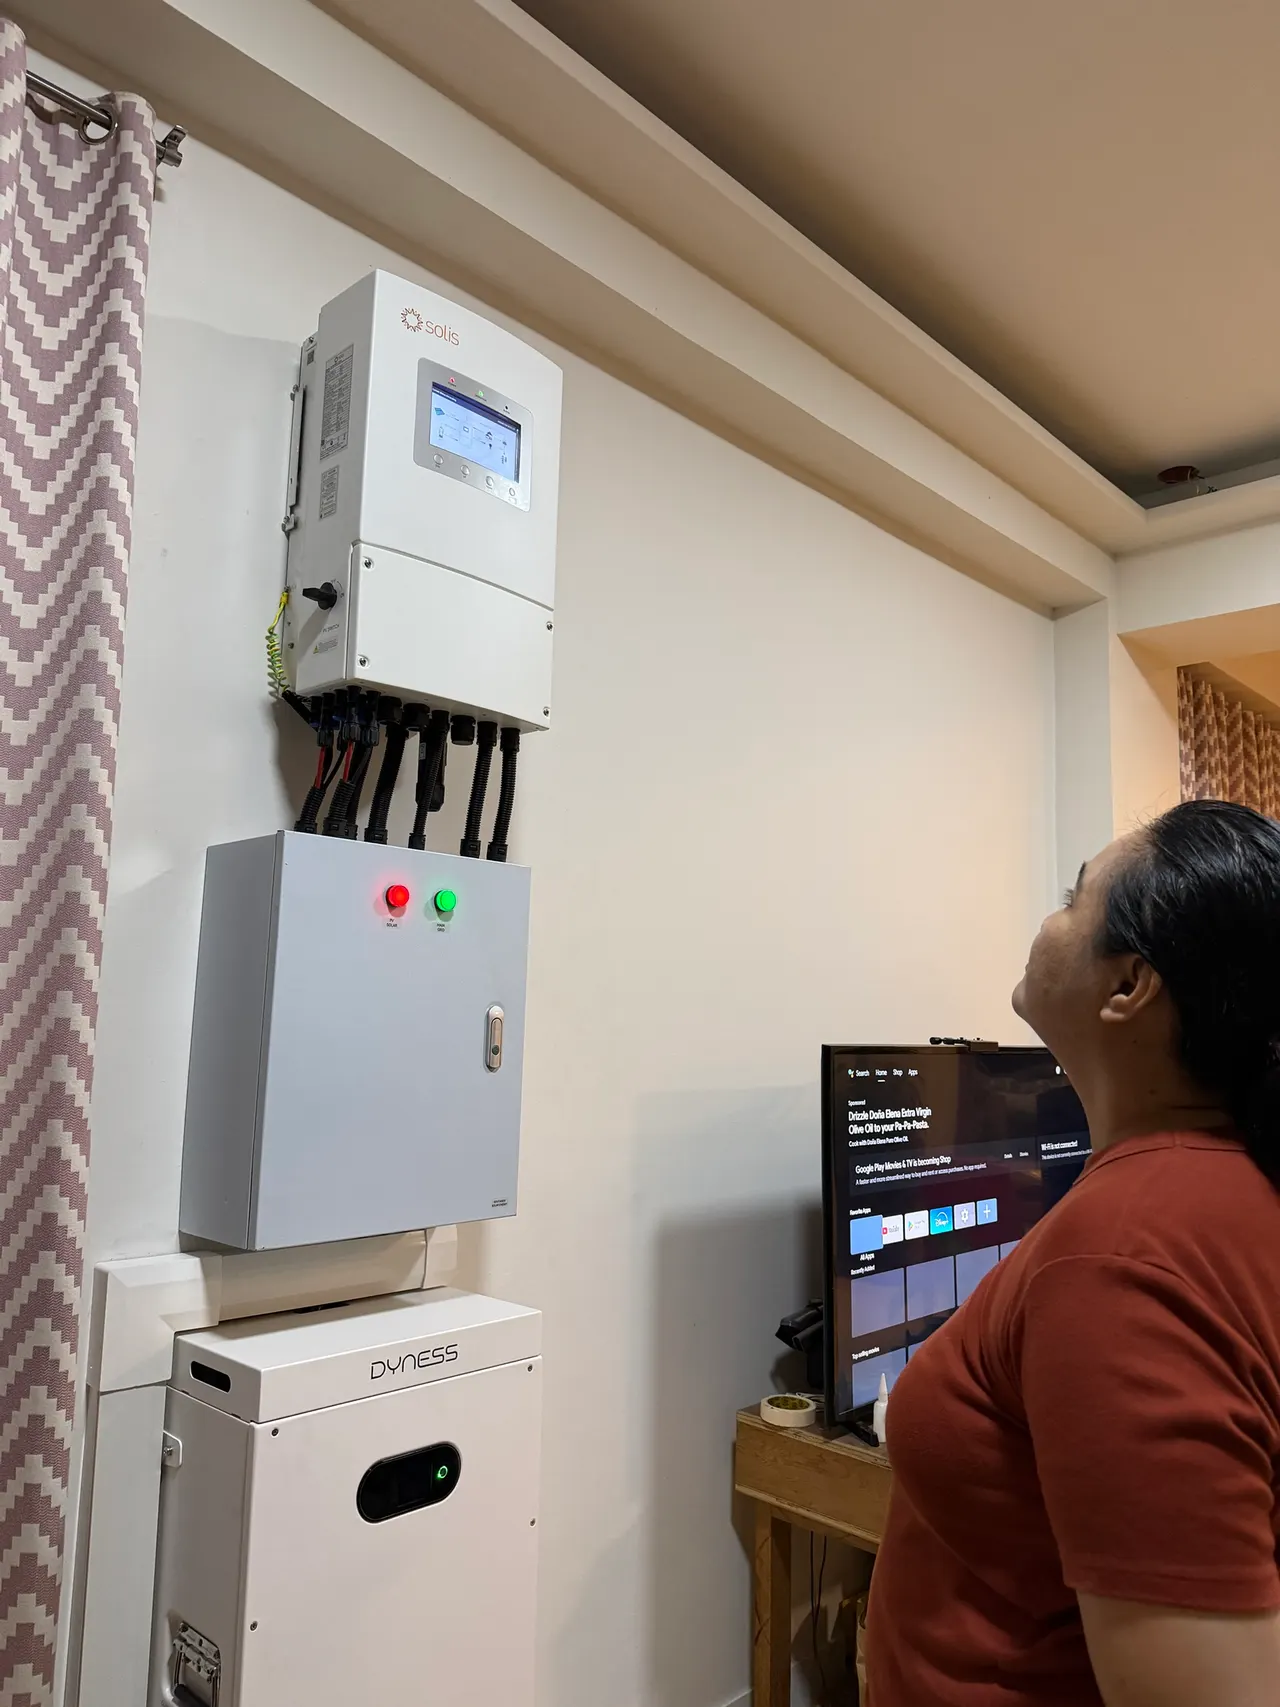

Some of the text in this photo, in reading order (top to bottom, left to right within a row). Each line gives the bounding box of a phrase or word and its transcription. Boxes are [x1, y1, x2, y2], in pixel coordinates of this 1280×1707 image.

[425, 320, 460, 346] solis
[893, 1068, 904, 1077] Shop
[908, 1068, 919, 1077] Apps
[848, 1107, 932, 1121] Drizzle Doña Elena Extra Virgin
[848, 1124, 864, 1135] Olive
[865, 1123, 873, 1133] Oil
[874, 1123, 881, 1133] to
[881, 1124, 894, 1134] your
[848, 1140, 859, 1148] Cook
[855, 1155, 952, 1175] Google Play Movies & TV is becoming Shop
[866, 1253, 875, 1261] Apps
[850, 1264, 875, 1276] Recently Added
[371, 1344, 458, 1380] DYNESS
